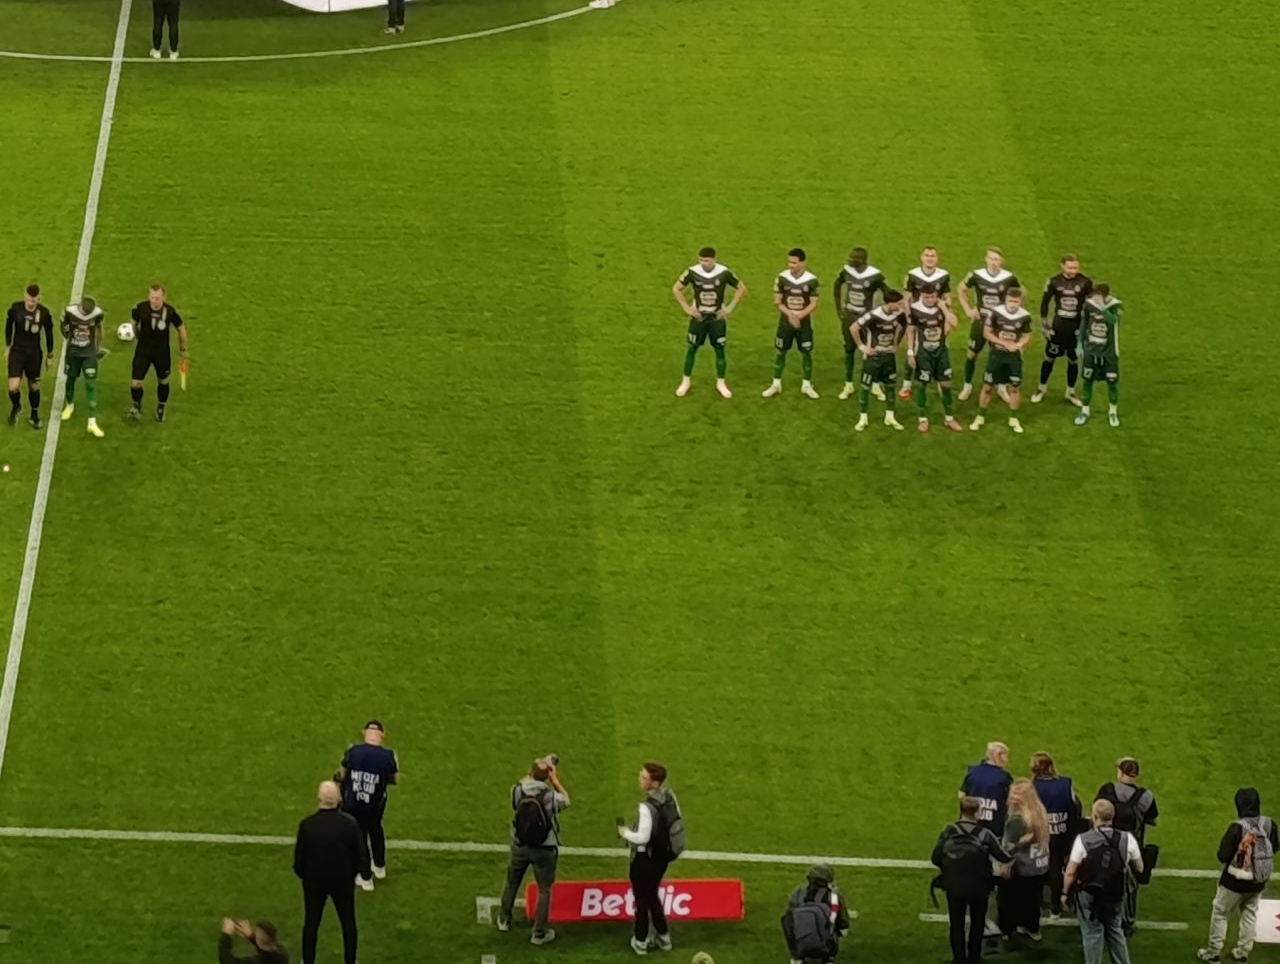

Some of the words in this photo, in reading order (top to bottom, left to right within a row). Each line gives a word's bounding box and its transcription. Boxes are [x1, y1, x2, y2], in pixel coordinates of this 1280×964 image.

[980, 798, 998, 811] DIA
[1048, 812, 1068, 824] EDIA
[1049, 823, 1067, 834] LUB
[580, 885, 693, 916] Betic
